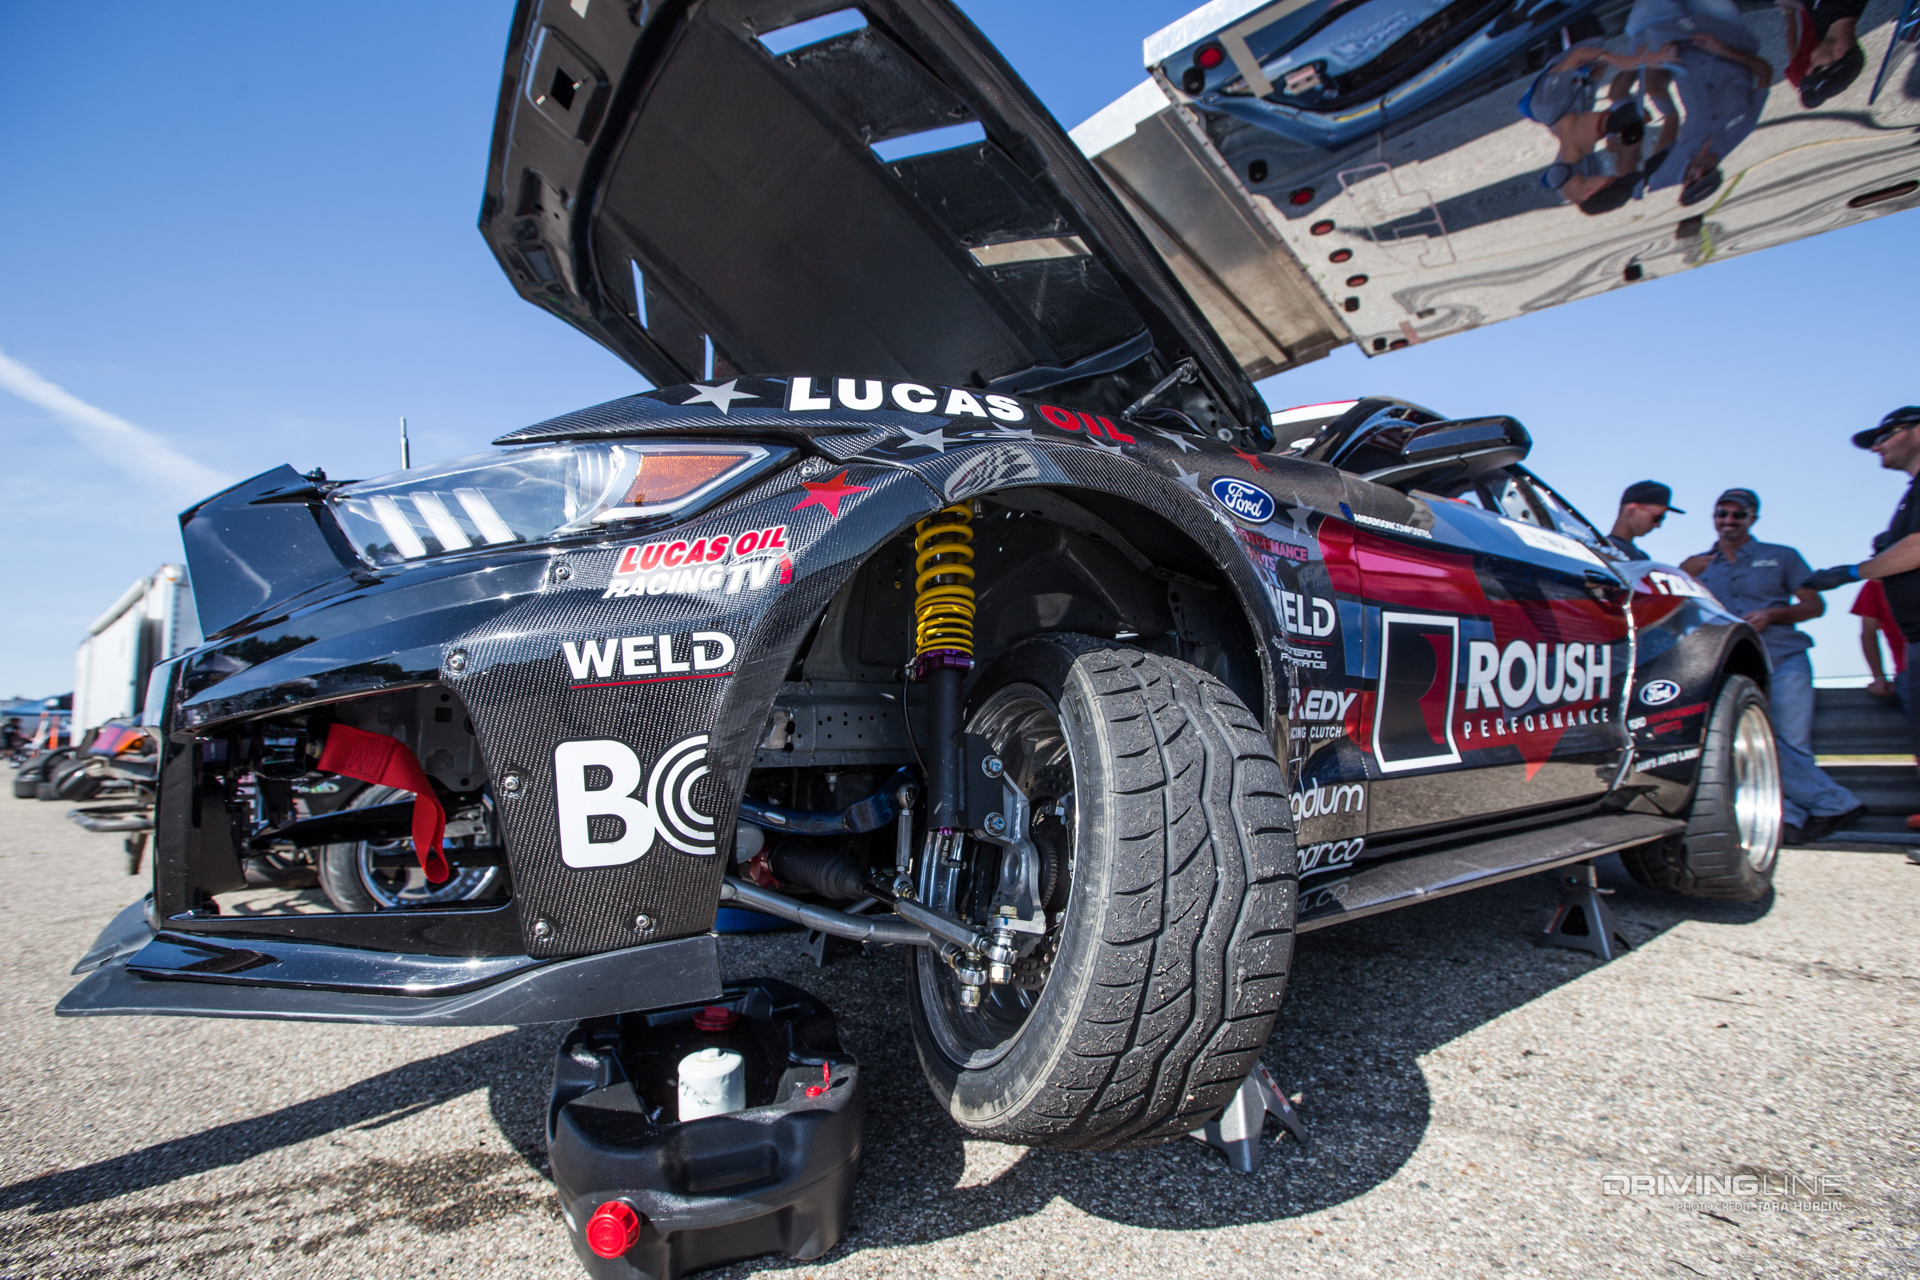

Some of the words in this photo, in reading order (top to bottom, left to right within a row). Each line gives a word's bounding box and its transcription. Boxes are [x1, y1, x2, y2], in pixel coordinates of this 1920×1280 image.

[789, 376, 1025, 422] LUCAS
[1039, 404, 1137, 445] OIL
[1224, 483, 1265, 517] Ford
[617, 535, 731, 574] LUCAS
[734, 526, 787, 556] OIL
[601, 564, 724, 600] RACING
[726, 557, 778, 595] TV
[562, 631, 736, 680] WELD
[1464, 639, 1612, 711] ROUSH
[1644, 683, 1674, 703] Ford
[1309, 725, 1343, 739] CLUTCH
[1463, 706, 1610, 740] PERFORMANCE
[554, 733, 717, 869] BC
[1288, 777, 1365, 822] adium
